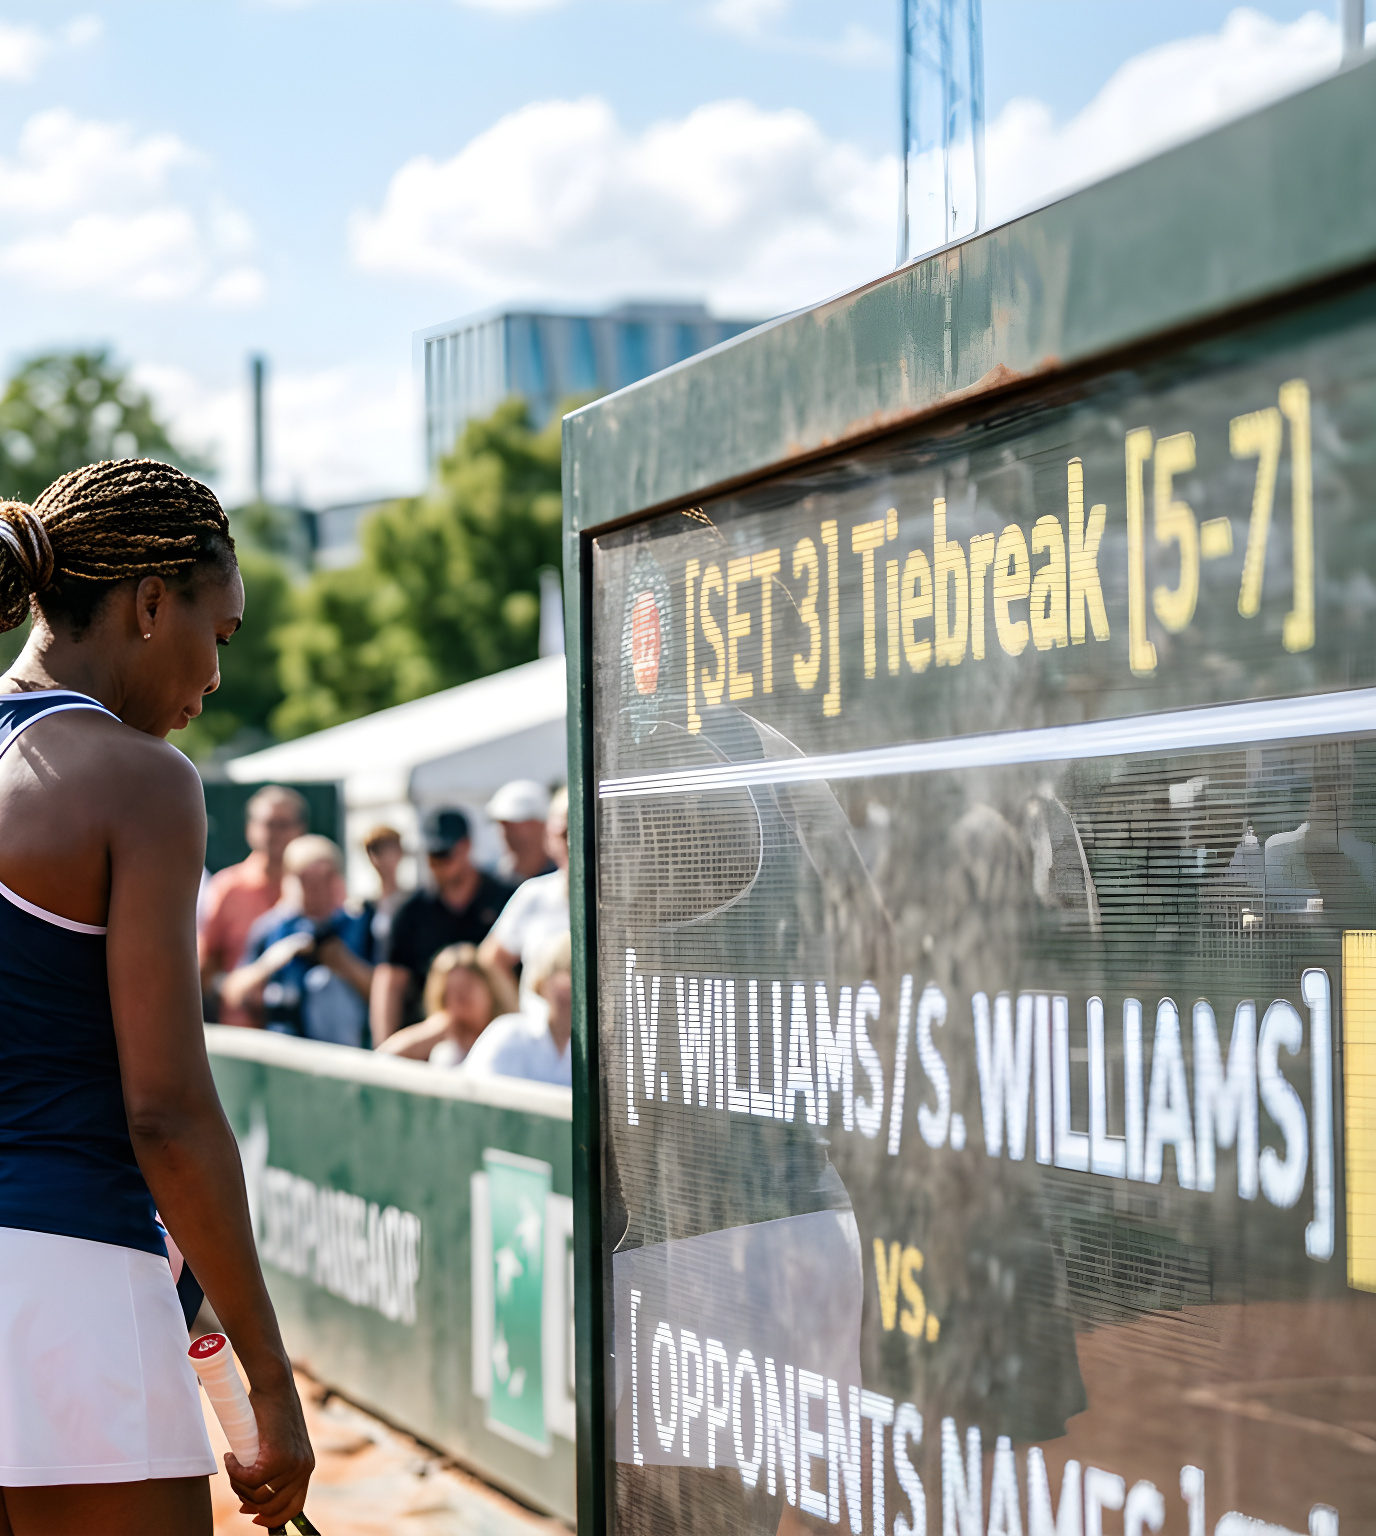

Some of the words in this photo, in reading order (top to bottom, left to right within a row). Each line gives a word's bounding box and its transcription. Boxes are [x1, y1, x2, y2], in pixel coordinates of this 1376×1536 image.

[685, 547, 781, 735] [SET
[792, 518, 842, 717] 3]
[851, 456, 1111, 680] Tiebreak
[1125, 377, 1317, 678] [5-7]
[971, 966, 1337, 1264] WILLIAMS]
